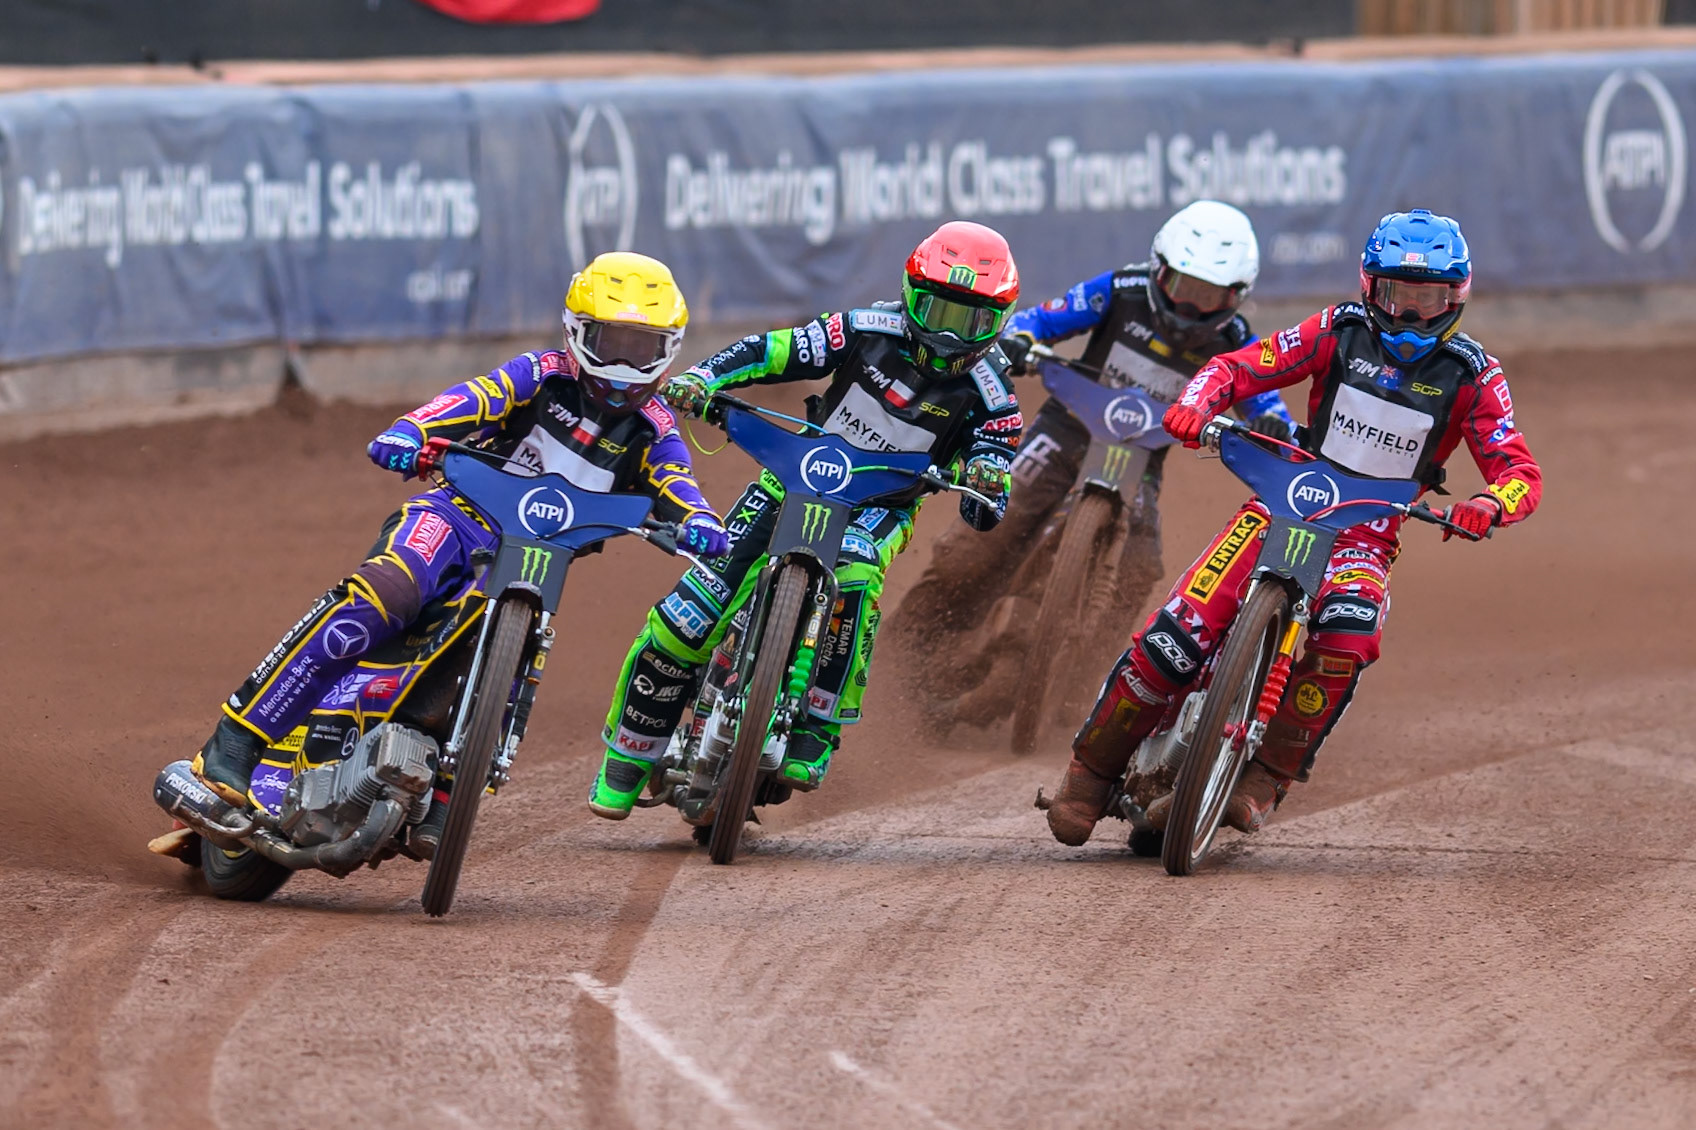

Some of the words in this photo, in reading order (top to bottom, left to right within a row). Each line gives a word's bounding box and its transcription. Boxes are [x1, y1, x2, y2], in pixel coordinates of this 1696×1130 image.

[328, 160, 479, 241] Solutions
[666, 153, 836, 246] Delivering
[839, 140, 944, 220] World
[948, 139, 1046, 217] Class
[1047, 134, 1162, 212] Travel
[1168, 130, 1347, 206] Solutions
[1411, 382, 1443, 396] SGP
[919, 401, 950, 417] SGP
[1333, 411, 1419, 452] MAYFIELD
[808, 459, 844, 480] ATPI
[1294, 485, 1330, 506] ATPI
[526, 501, 564, 523] ATPI
[1209, 517, 1256, 570] ENTRAC
[836, 617, 855, 655] TEMAR
[258, 655, 314, 717] Mercedes-Benz
[625, 704, 668, 728] BETPOL
[165, 772, 207, 804] PISKORSKI
